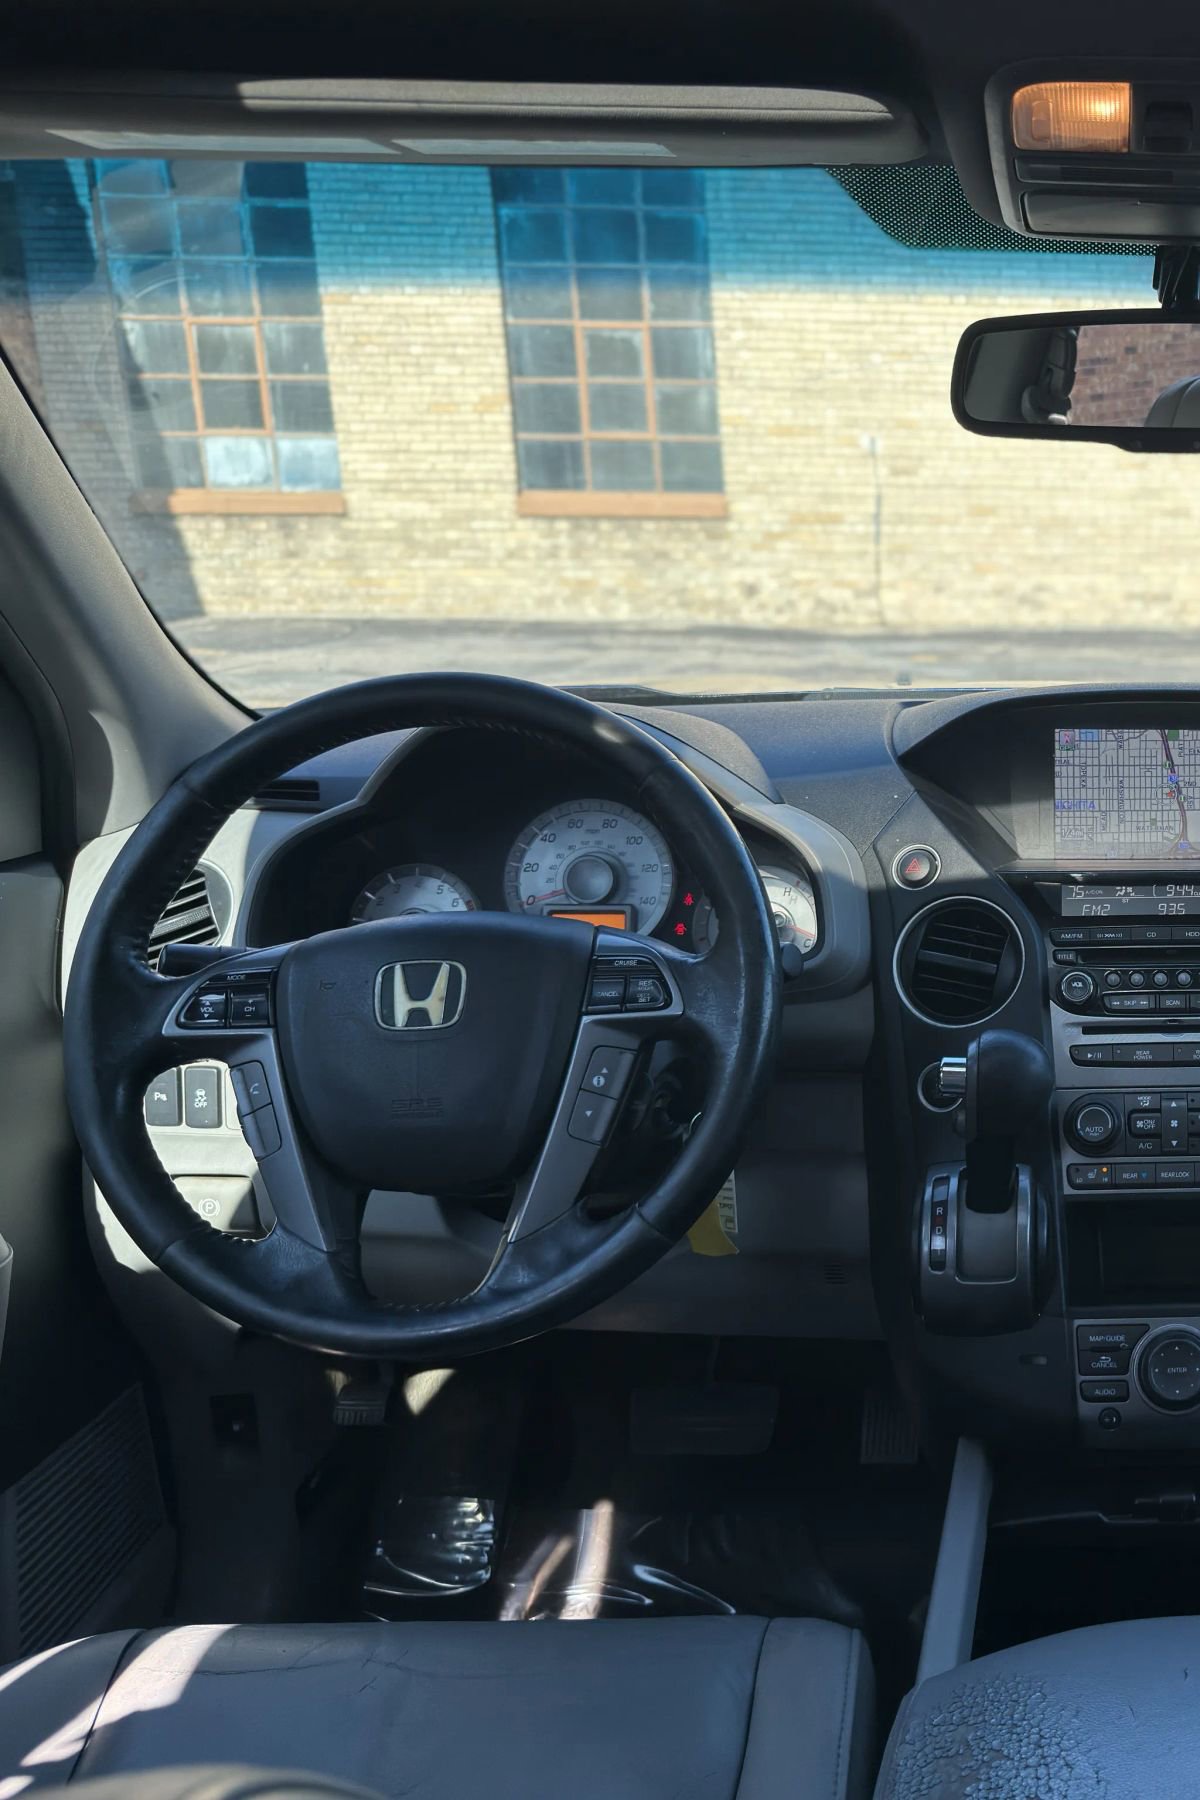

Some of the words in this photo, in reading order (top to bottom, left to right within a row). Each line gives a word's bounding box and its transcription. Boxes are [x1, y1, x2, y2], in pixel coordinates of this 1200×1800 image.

[568, 818, 583, 828] 60
[602, 818, 617, 828] 80
[541, 833, 556, 844] 40
[626, 836, 643, 845] 100
[523, 863, 539, 872] 20
[641, 864, 659, 873] 120
[436, 885, 444, 895] 5
[784, 887, 792, 896] H
[1067, 885, 1085, 898] 75
[451, 897, 459, 907] 6
[526, 895, 536, 905] 0
[640, 896, 656, 905] 140
[1082, 904, 1111, 916] FM2
[936, 1206, 944, 1216] R
[935, 1226, 943, 1235] D
